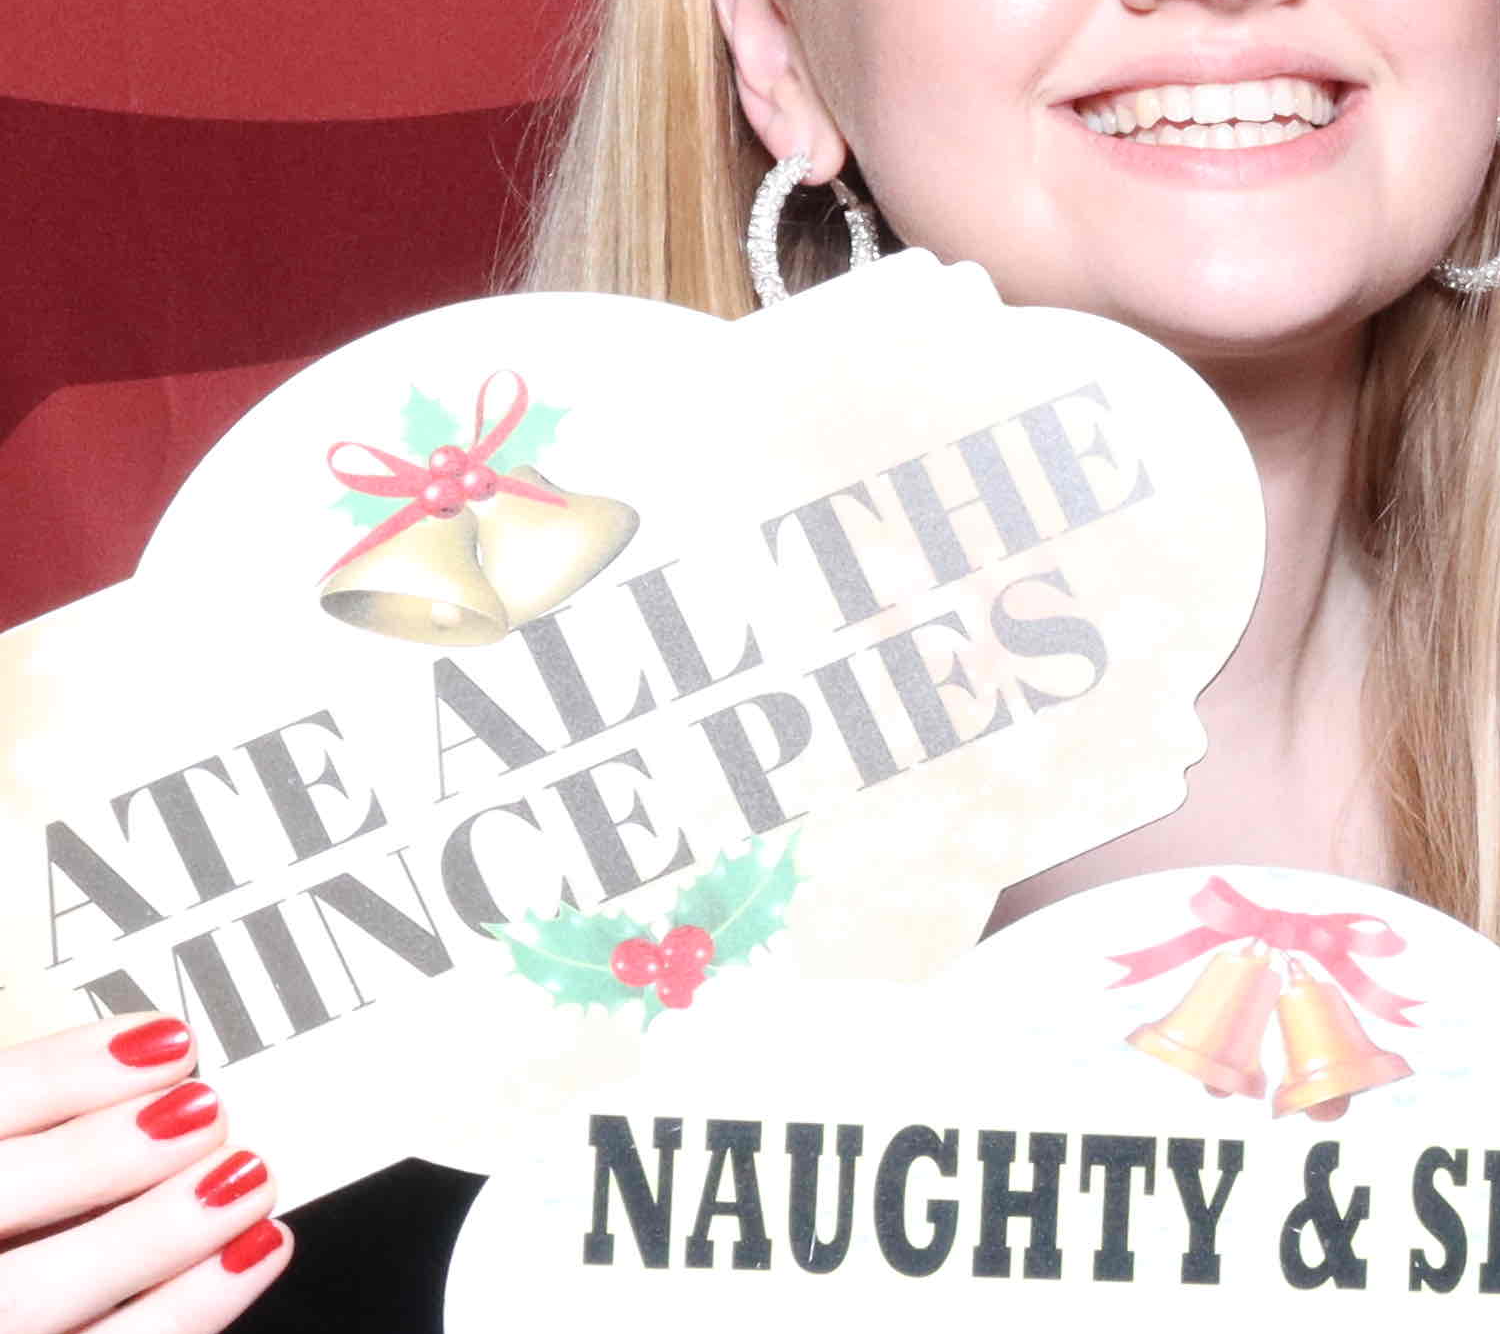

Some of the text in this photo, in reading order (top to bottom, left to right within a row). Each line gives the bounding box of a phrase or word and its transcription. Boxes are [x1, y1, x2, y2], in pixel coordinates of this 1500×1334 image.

[45, 380, 1156, 970] ATE ALL THE
[687, 567, 1108, 842] PIES
[584, 1114, 1244, 1285] NAUGHTY
[1279, 1141, 1370, 1289] &
